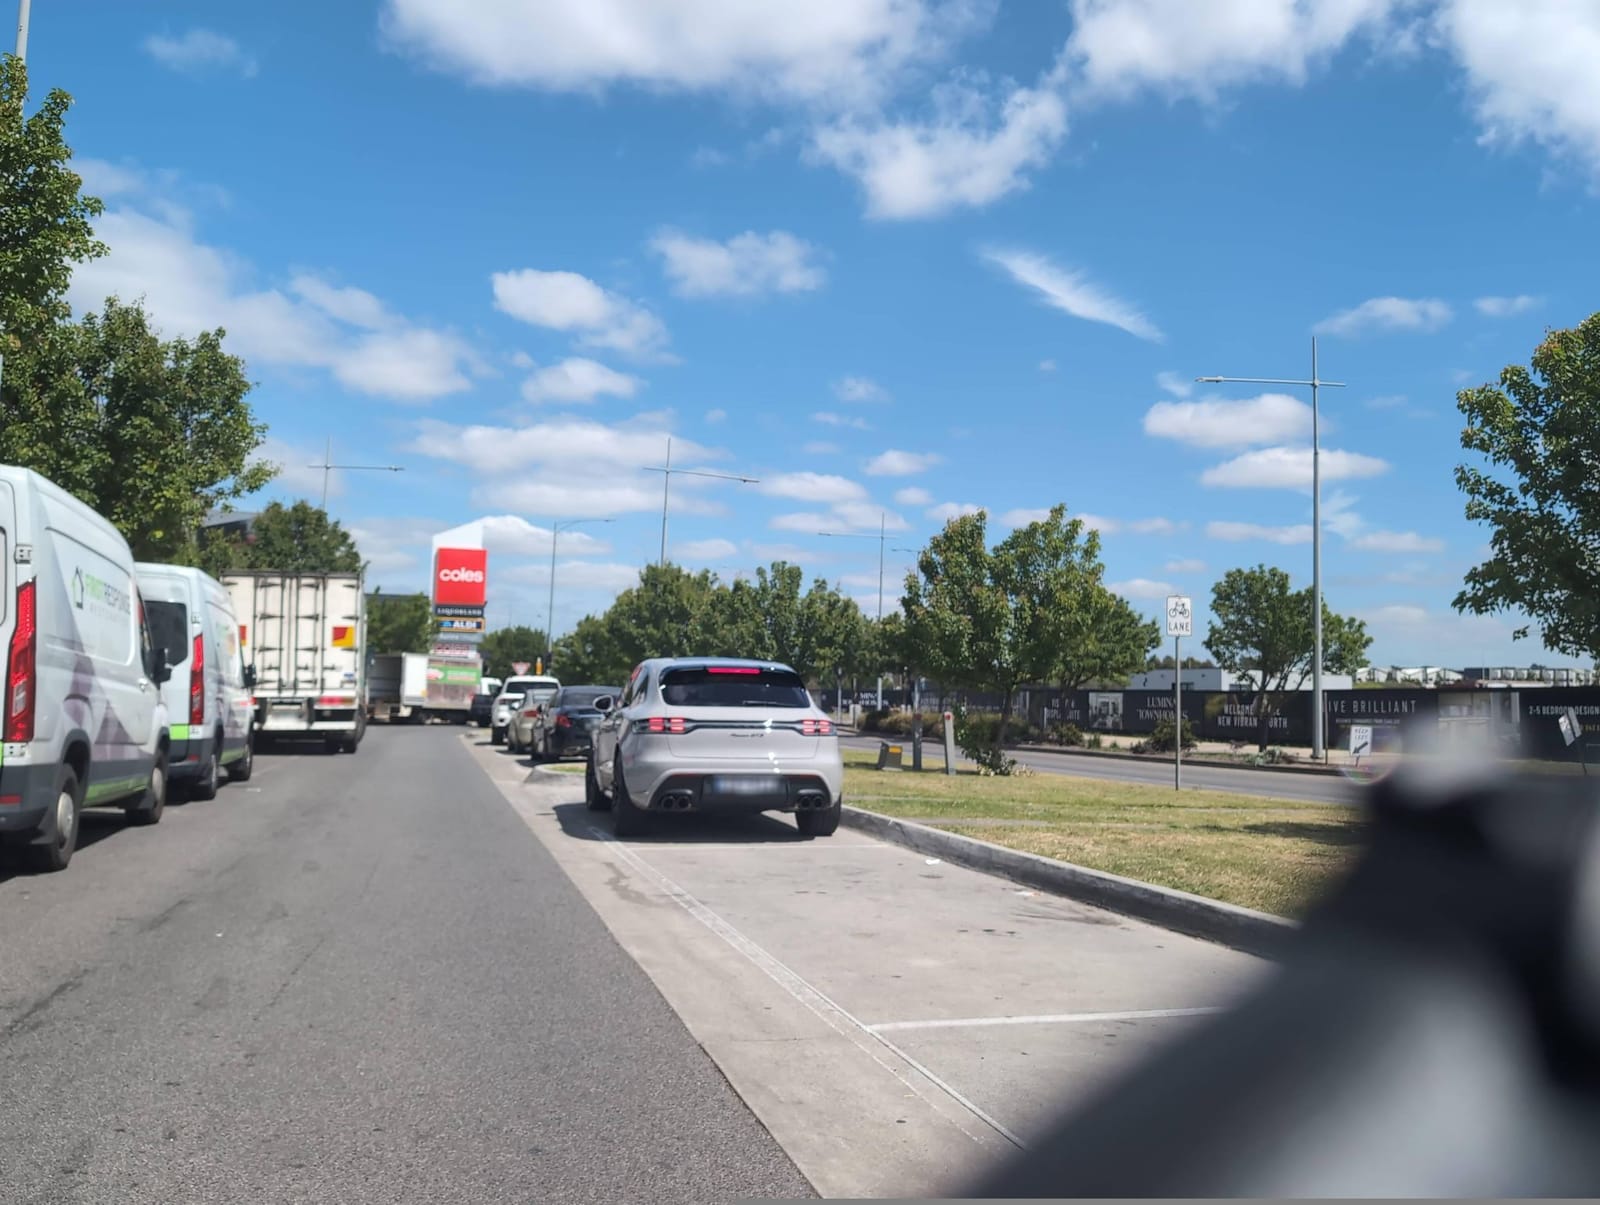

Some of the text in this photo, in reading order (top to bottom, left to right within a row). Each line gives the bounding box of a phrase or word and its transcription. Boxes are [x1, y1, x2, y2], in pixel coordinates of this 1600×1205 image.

[439, 567, 484, 583] coles
[452, 620, 477, 629] ALDI
[1168, 622, 1190, 632] LANE
[1223, 703, 1255, 715] WELCOME
[1352, 700, 1416, 713] BRILLIANT
[1542, 705, 1573, 715] BEDROO
[1217, 716, 1288, 728] NEW VIBRAN ORTH
